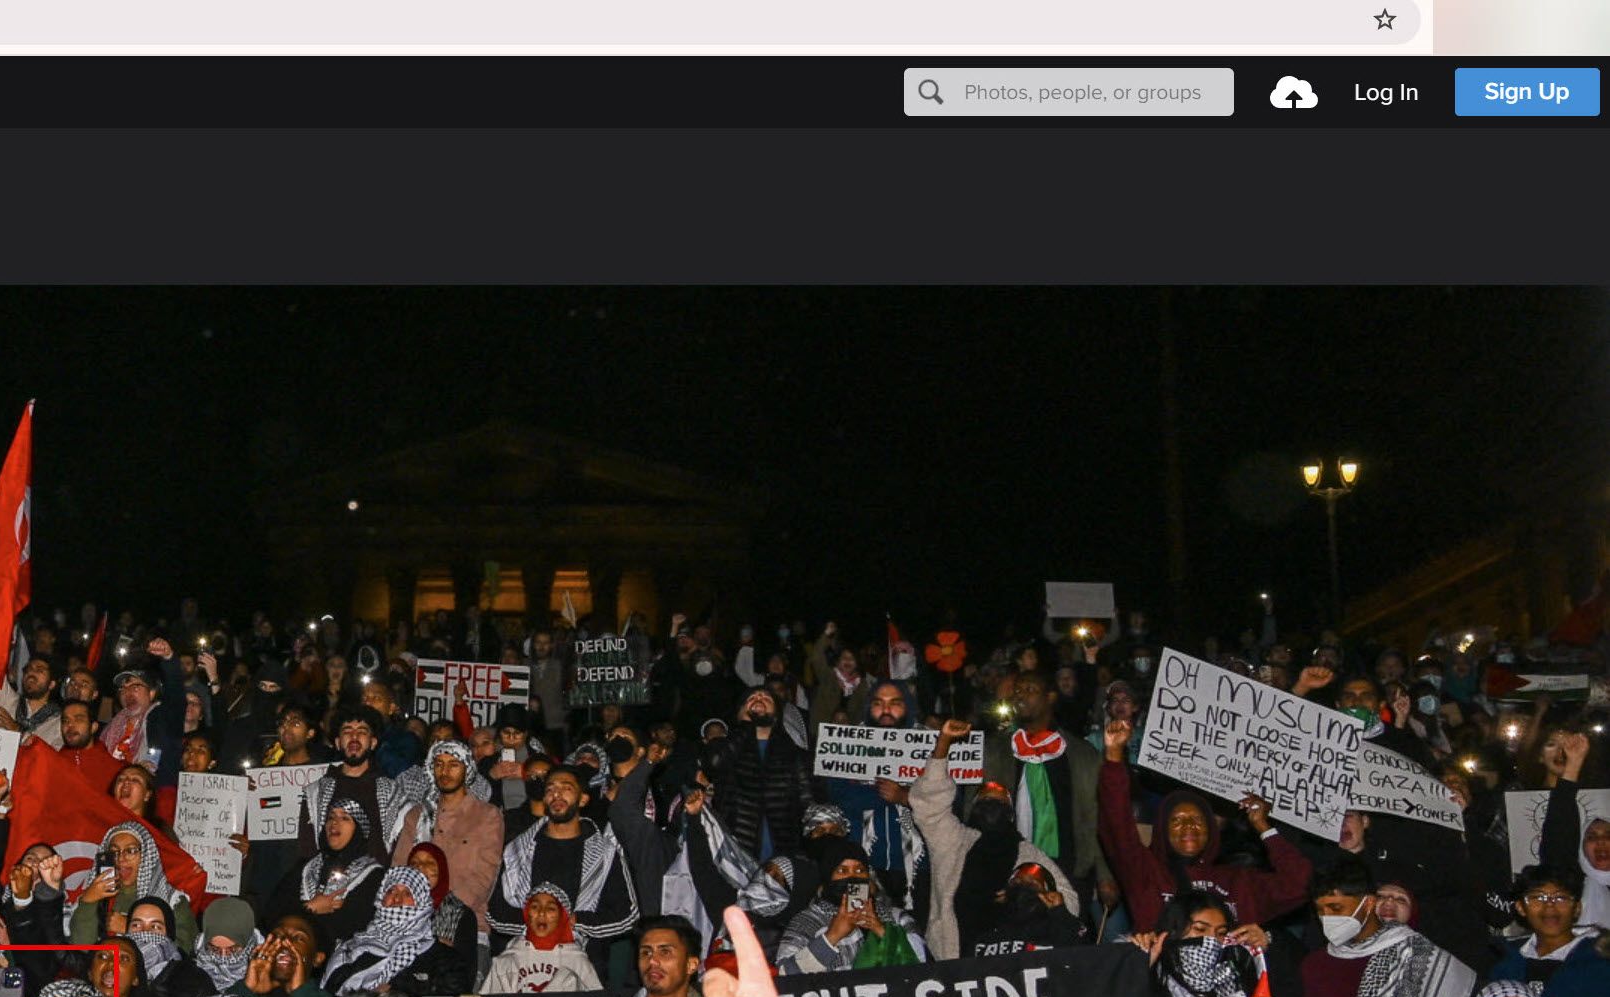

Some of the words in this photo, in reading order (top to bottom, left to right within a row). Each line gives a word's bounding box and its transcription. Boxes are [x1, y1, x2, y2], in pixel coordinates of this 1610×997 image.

[965, 84, 1033, 103] Photos,
[1039, 84, 1107, 104] people,
[1114, 87, 1132, 100] or
[1138, 87, 1202, 104] groups
[1354, 83, 1394, 106] Log
[1400, 83, 1419, 101] In
[1484, 81, 1532, 105] Sign
[1538, 82, 1570, 105] Up
[575, 638, 627, 655] DEFUND
[444, 662, 501, 701] FREE
[577, 665, 634, 682] DEFEND
[1165, 655, 1199, 690] OH
[1217, 675, 1363, 752] MUSLIMS
[824, 725, 875, 741] THERE
[883, 731, 897, 741] IS
[1157, 687, 1196, 714] DO
[1206, 705, 1239, 732] NOT
[1246, 719, 1302, 751] LOOSE
[1308, 741, 1358, 773] HOPE
[818, 741, 886, 758] SOLUTION
[910, 749, 981, 761] GECIDE
[1149, 731, 1209, 761] SEEK
[1215, 754, 1250, 779] ONLY
[1159, 712, 1183, 734] IN
[1191, 721, 1227, 749] THE
[1236, 738, 1291, 771] MERCY
[1310, 764, 1353, 798] ALLAH
[822, 760, 867, 775] WHICH
[876, 765, 891, 776] IS
[1369, 770, 1425, 794] GAZA
